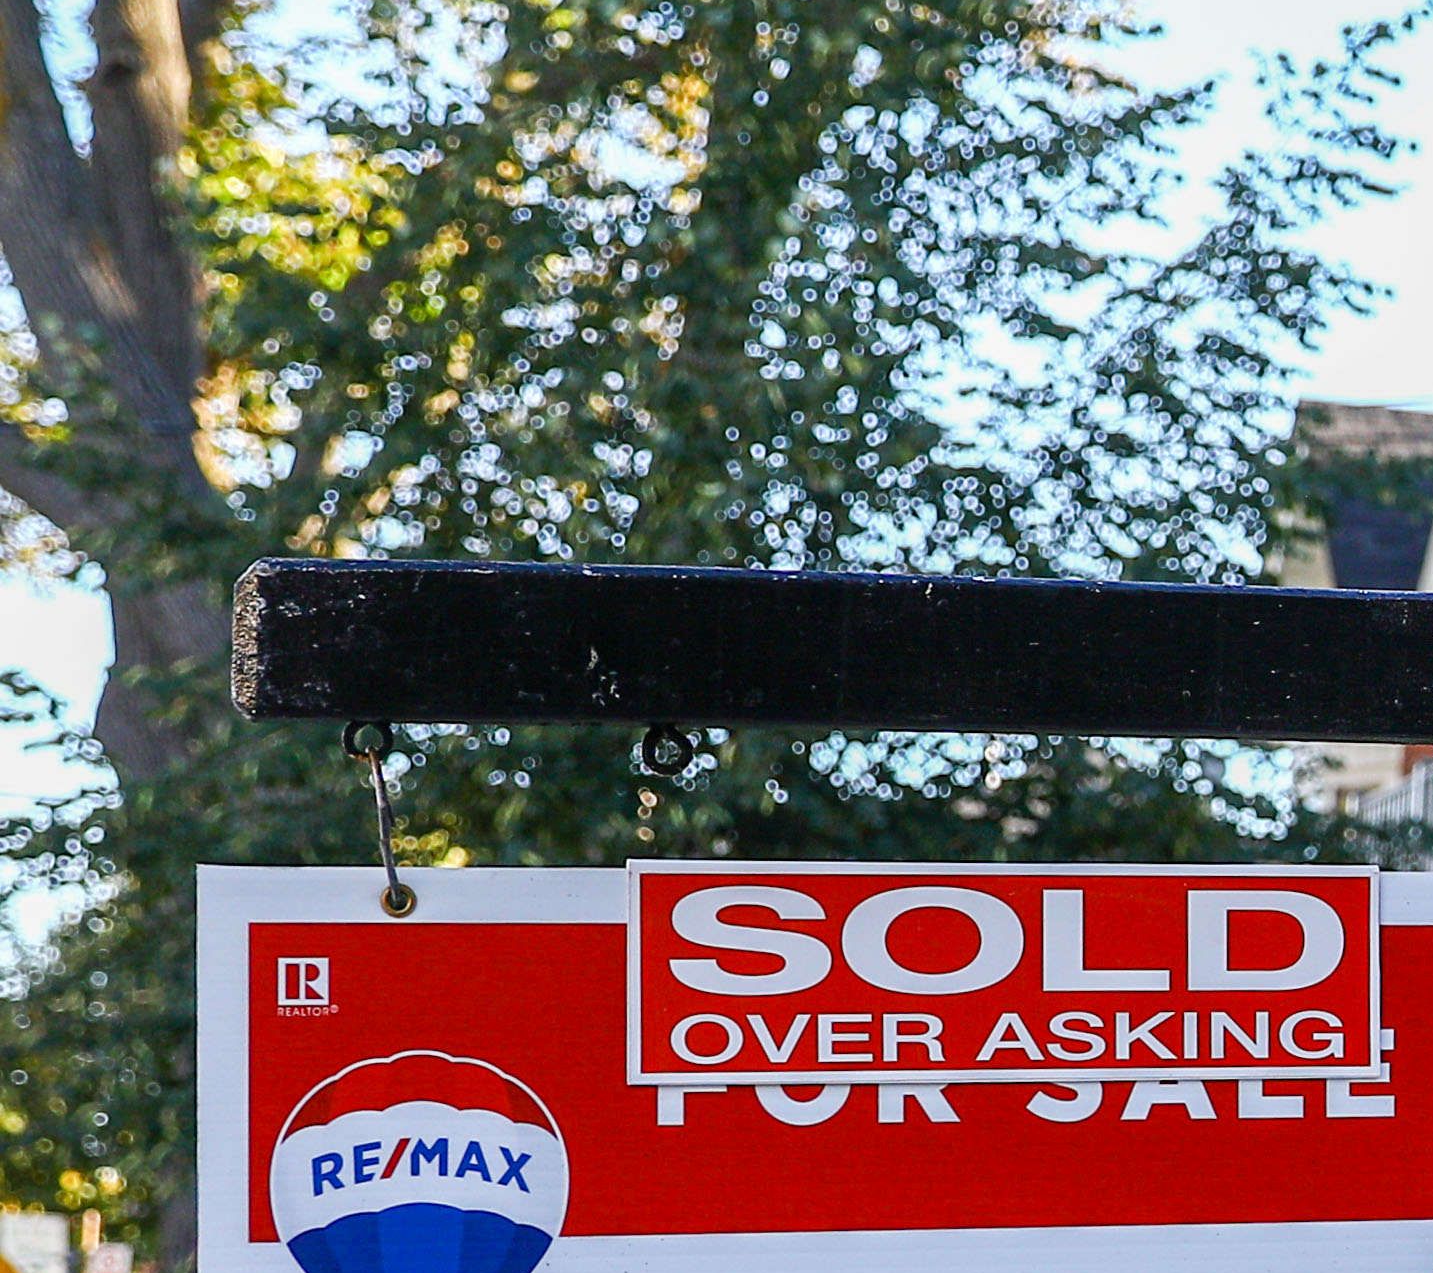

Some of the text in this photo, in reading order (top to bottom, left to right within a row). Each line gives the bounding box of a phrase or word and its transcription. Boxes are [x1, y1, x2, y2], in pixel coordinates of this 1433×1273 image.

[669, 885, 1345, 996] SOLD
[670, 1010, 1344, 1065] OVER ASKING
[311, 1137, 533, 1197] RE/MAX
